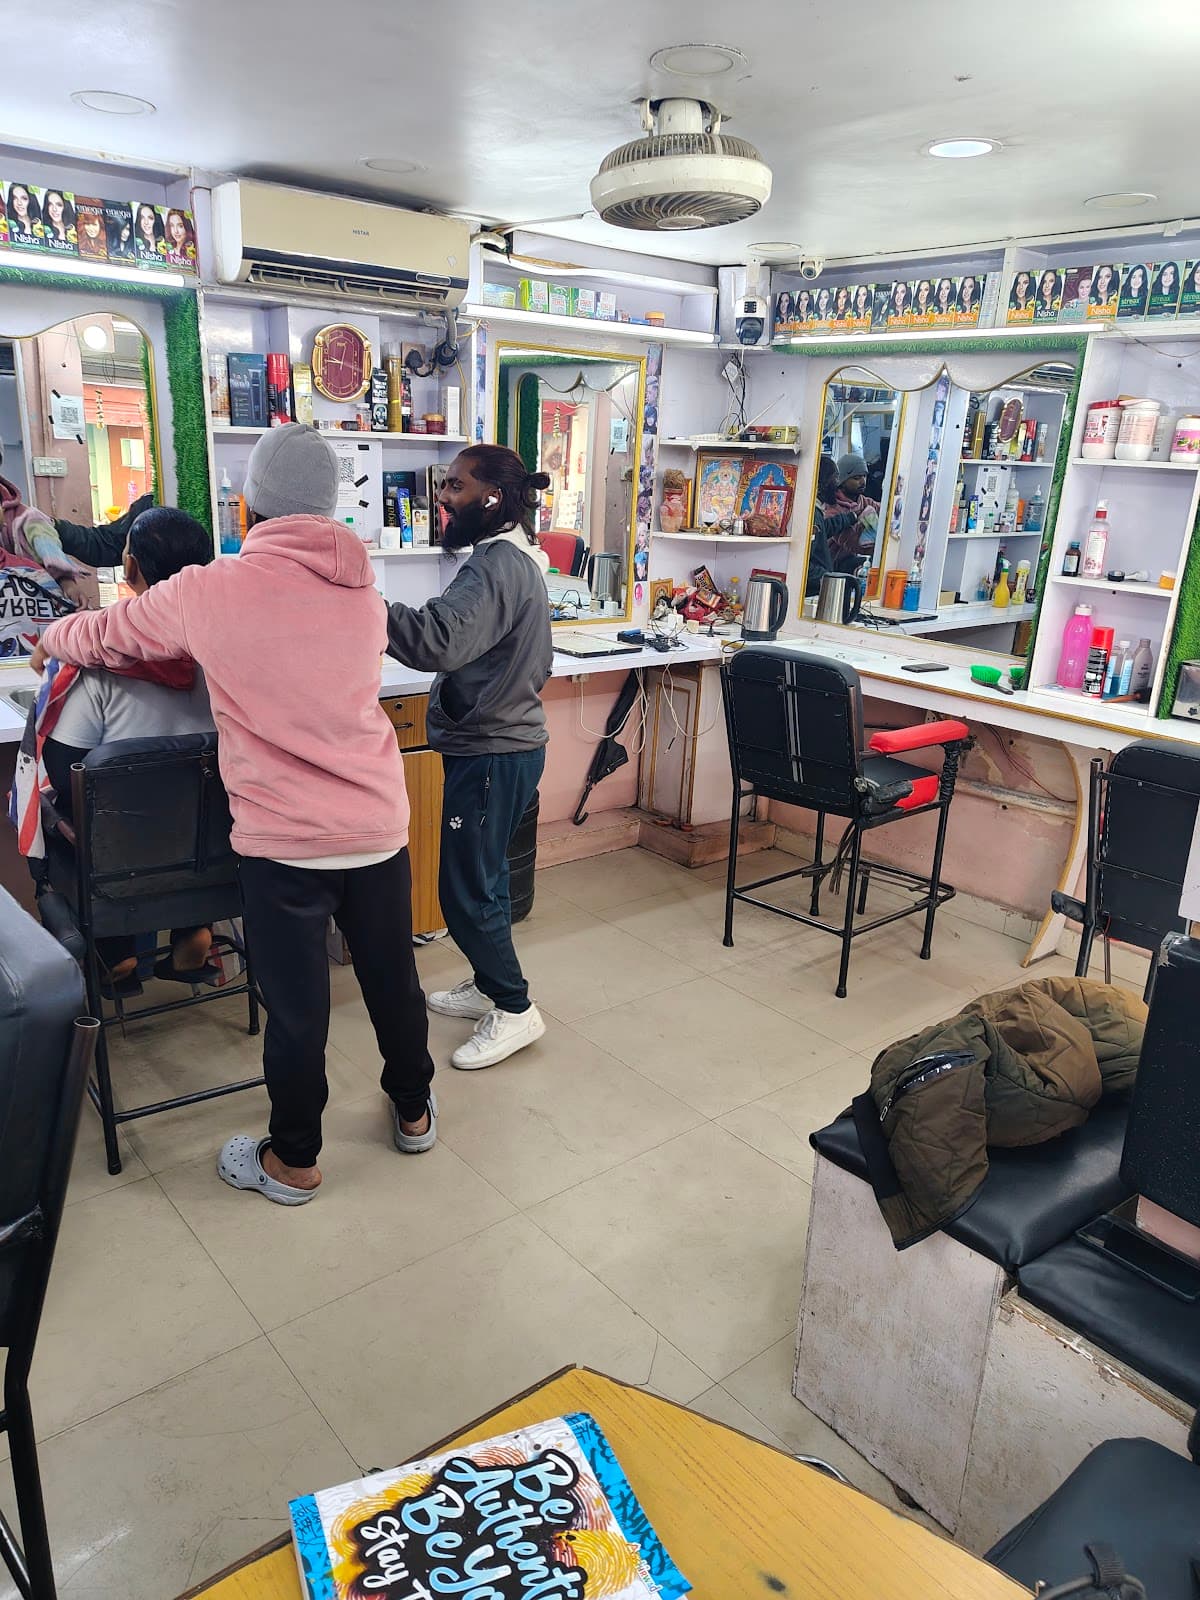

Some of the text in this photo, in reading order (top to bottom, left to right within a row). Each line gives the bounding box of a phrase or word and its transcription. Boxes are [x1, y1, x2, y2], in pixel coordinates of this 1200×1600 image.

[14, 233, 40, 245] Nisha
[48, 239, 74, 250] Nisha
[140, 251, 163, 262] Nisha
[170, 255, 192, 265] Nisha
[1036, 310, 1055, 318] Nisha
[1090, 307, 1112, 315] Nisha
[513, 1453, 574, 1524] Be
[401, 1484, 466, 1559] Be
[360, 1515, 410, 1589] Stay
